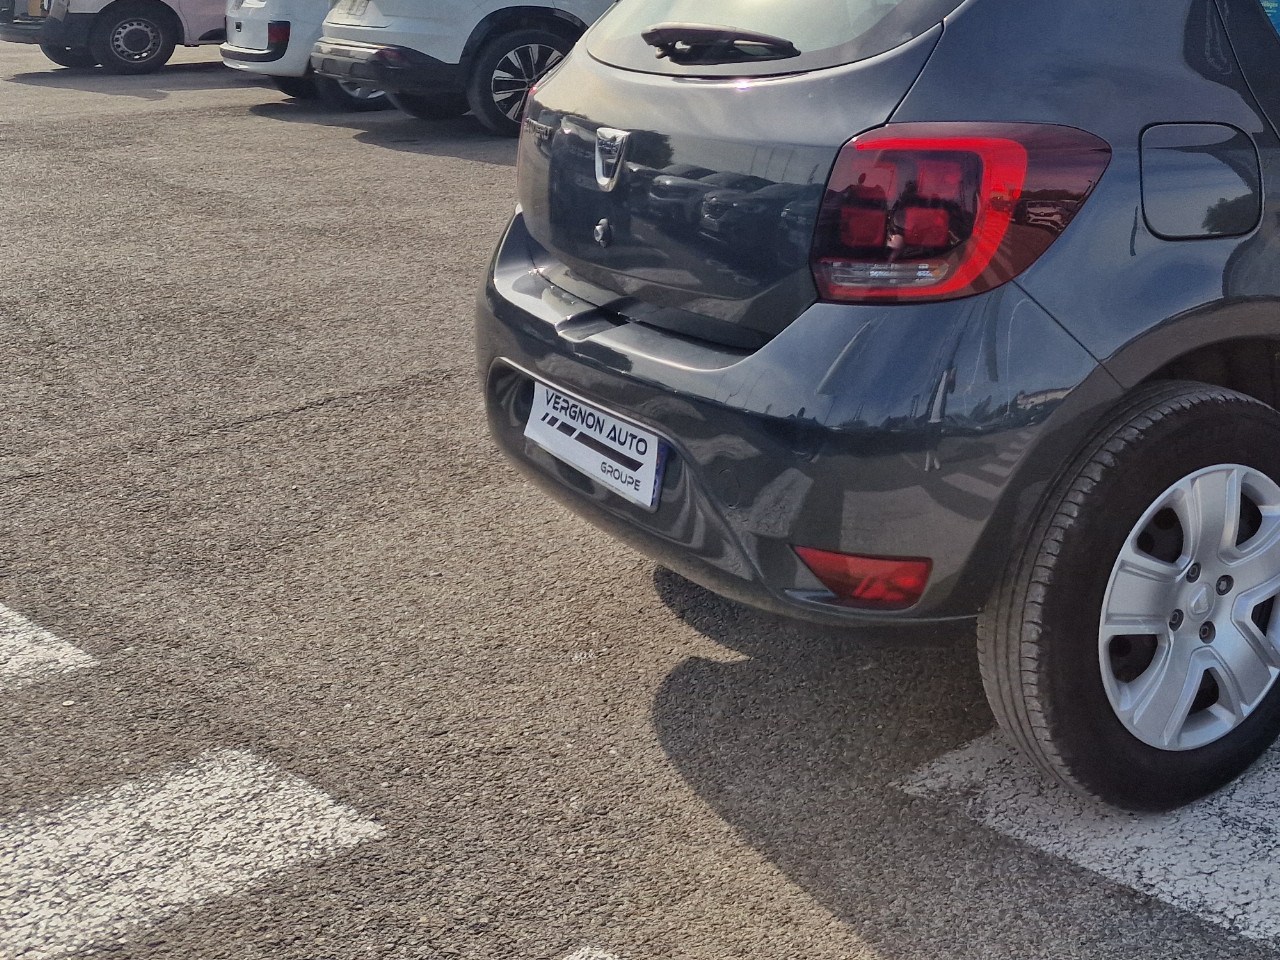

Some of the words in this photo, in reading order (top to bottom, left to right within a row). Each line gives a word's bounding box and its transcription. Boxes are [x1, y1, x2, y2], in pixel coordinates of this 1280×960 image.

[545, 389, 605, 435] VERGNON
[606, 424, 648, 455] AUTO
[600, 461, 641, 491] GROUPE
